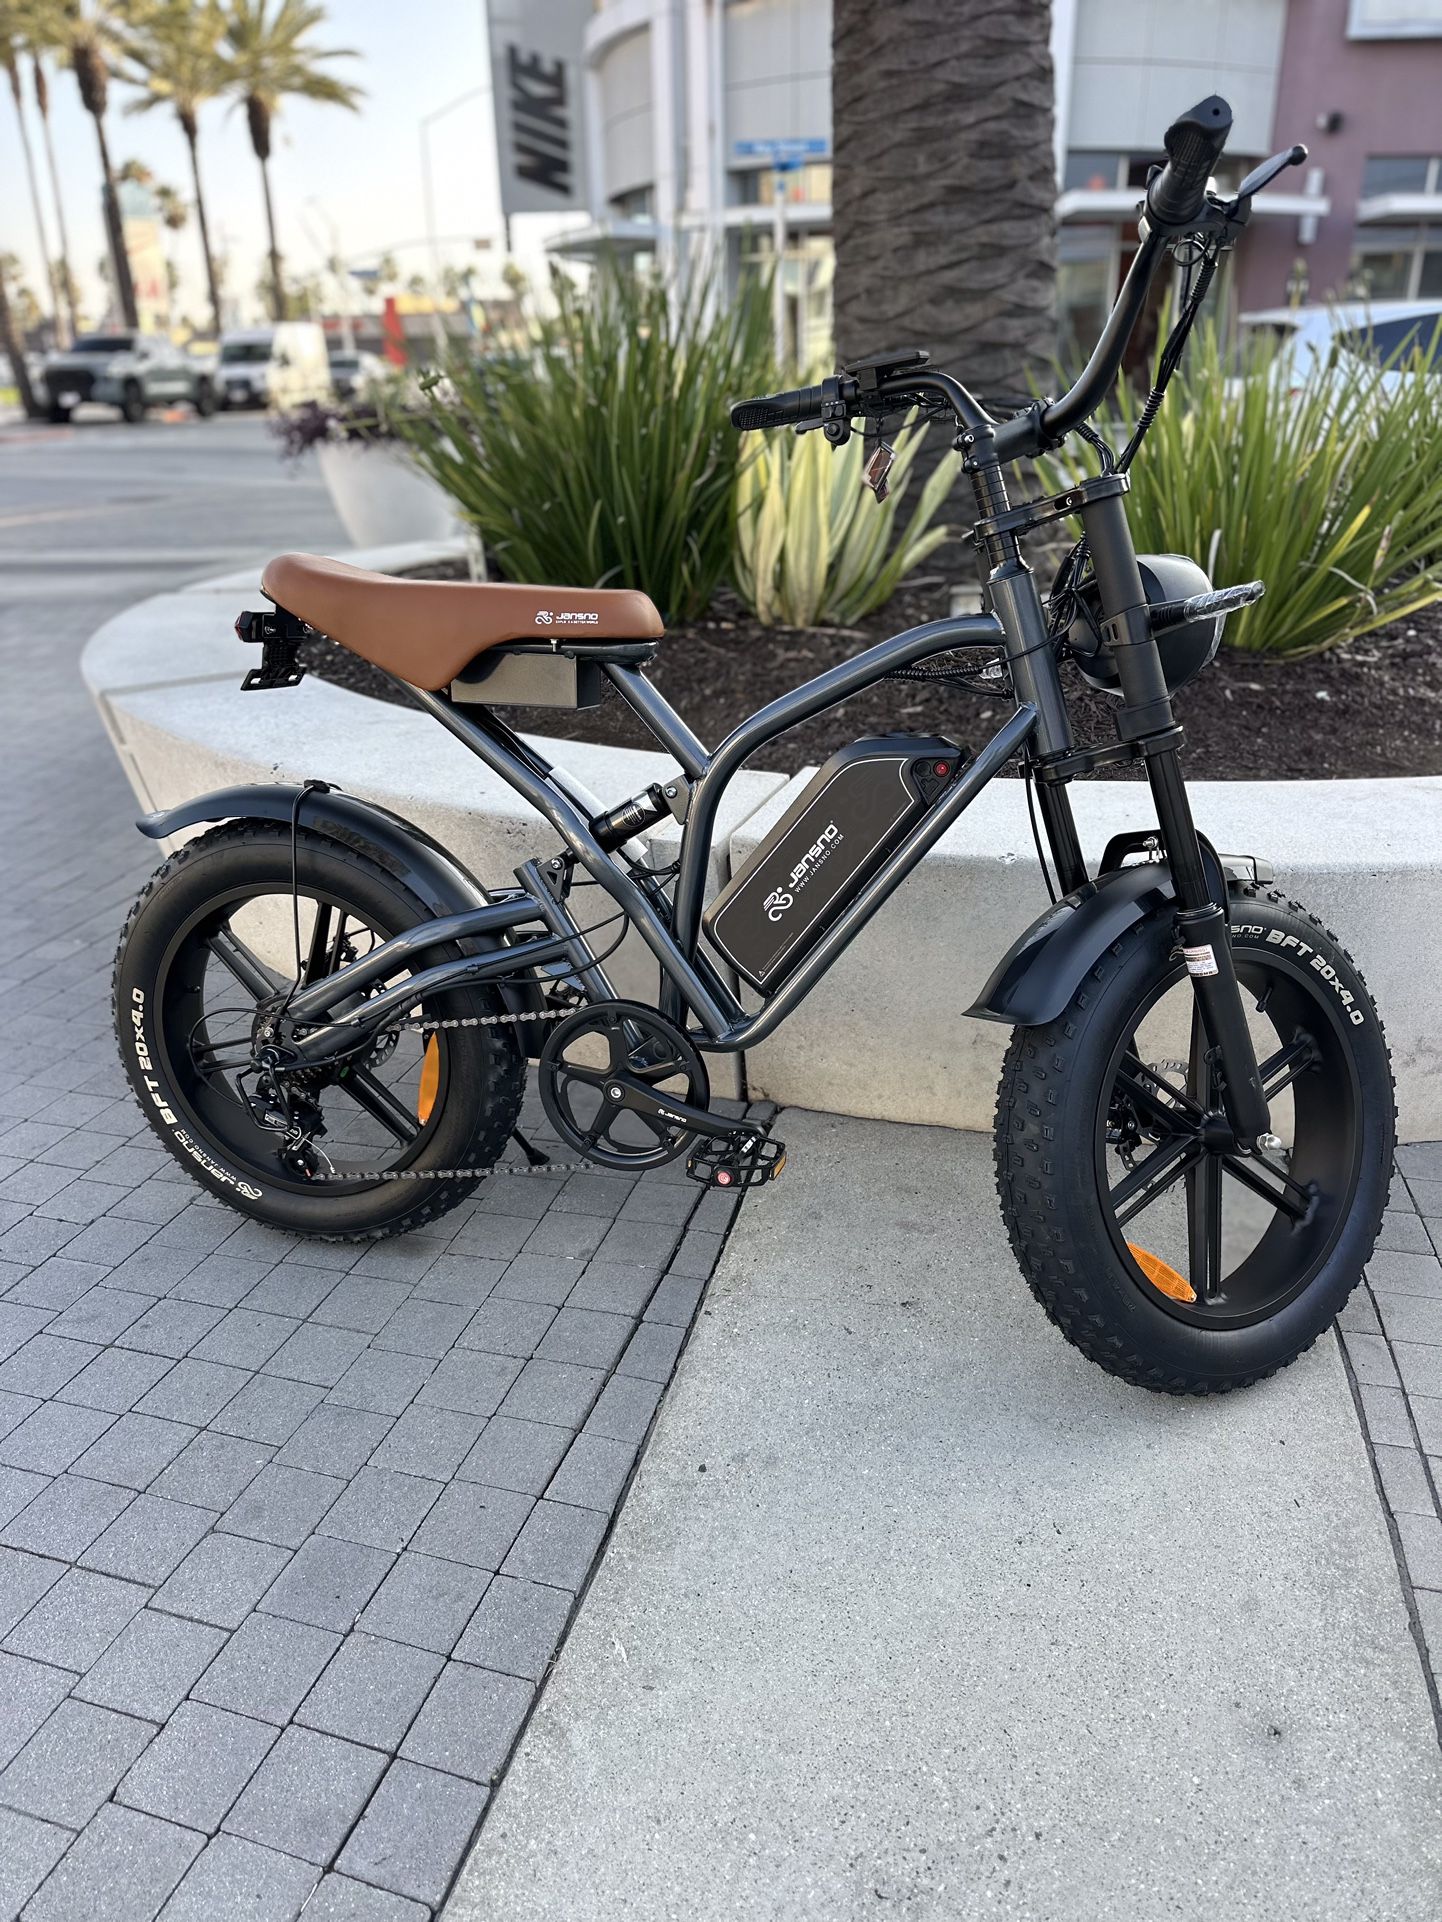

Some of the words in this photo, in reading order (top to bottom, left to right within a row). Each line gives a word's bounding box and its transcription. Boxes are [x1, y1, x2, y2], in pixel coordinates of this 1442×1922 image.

[508, 43, 571, 198] NIKE
[794, 833, 844, 893] WWW.JANSNO.COM
[1265, 929, 1313, 957] BFT
[143, 1075, 178, 1125] BFT
